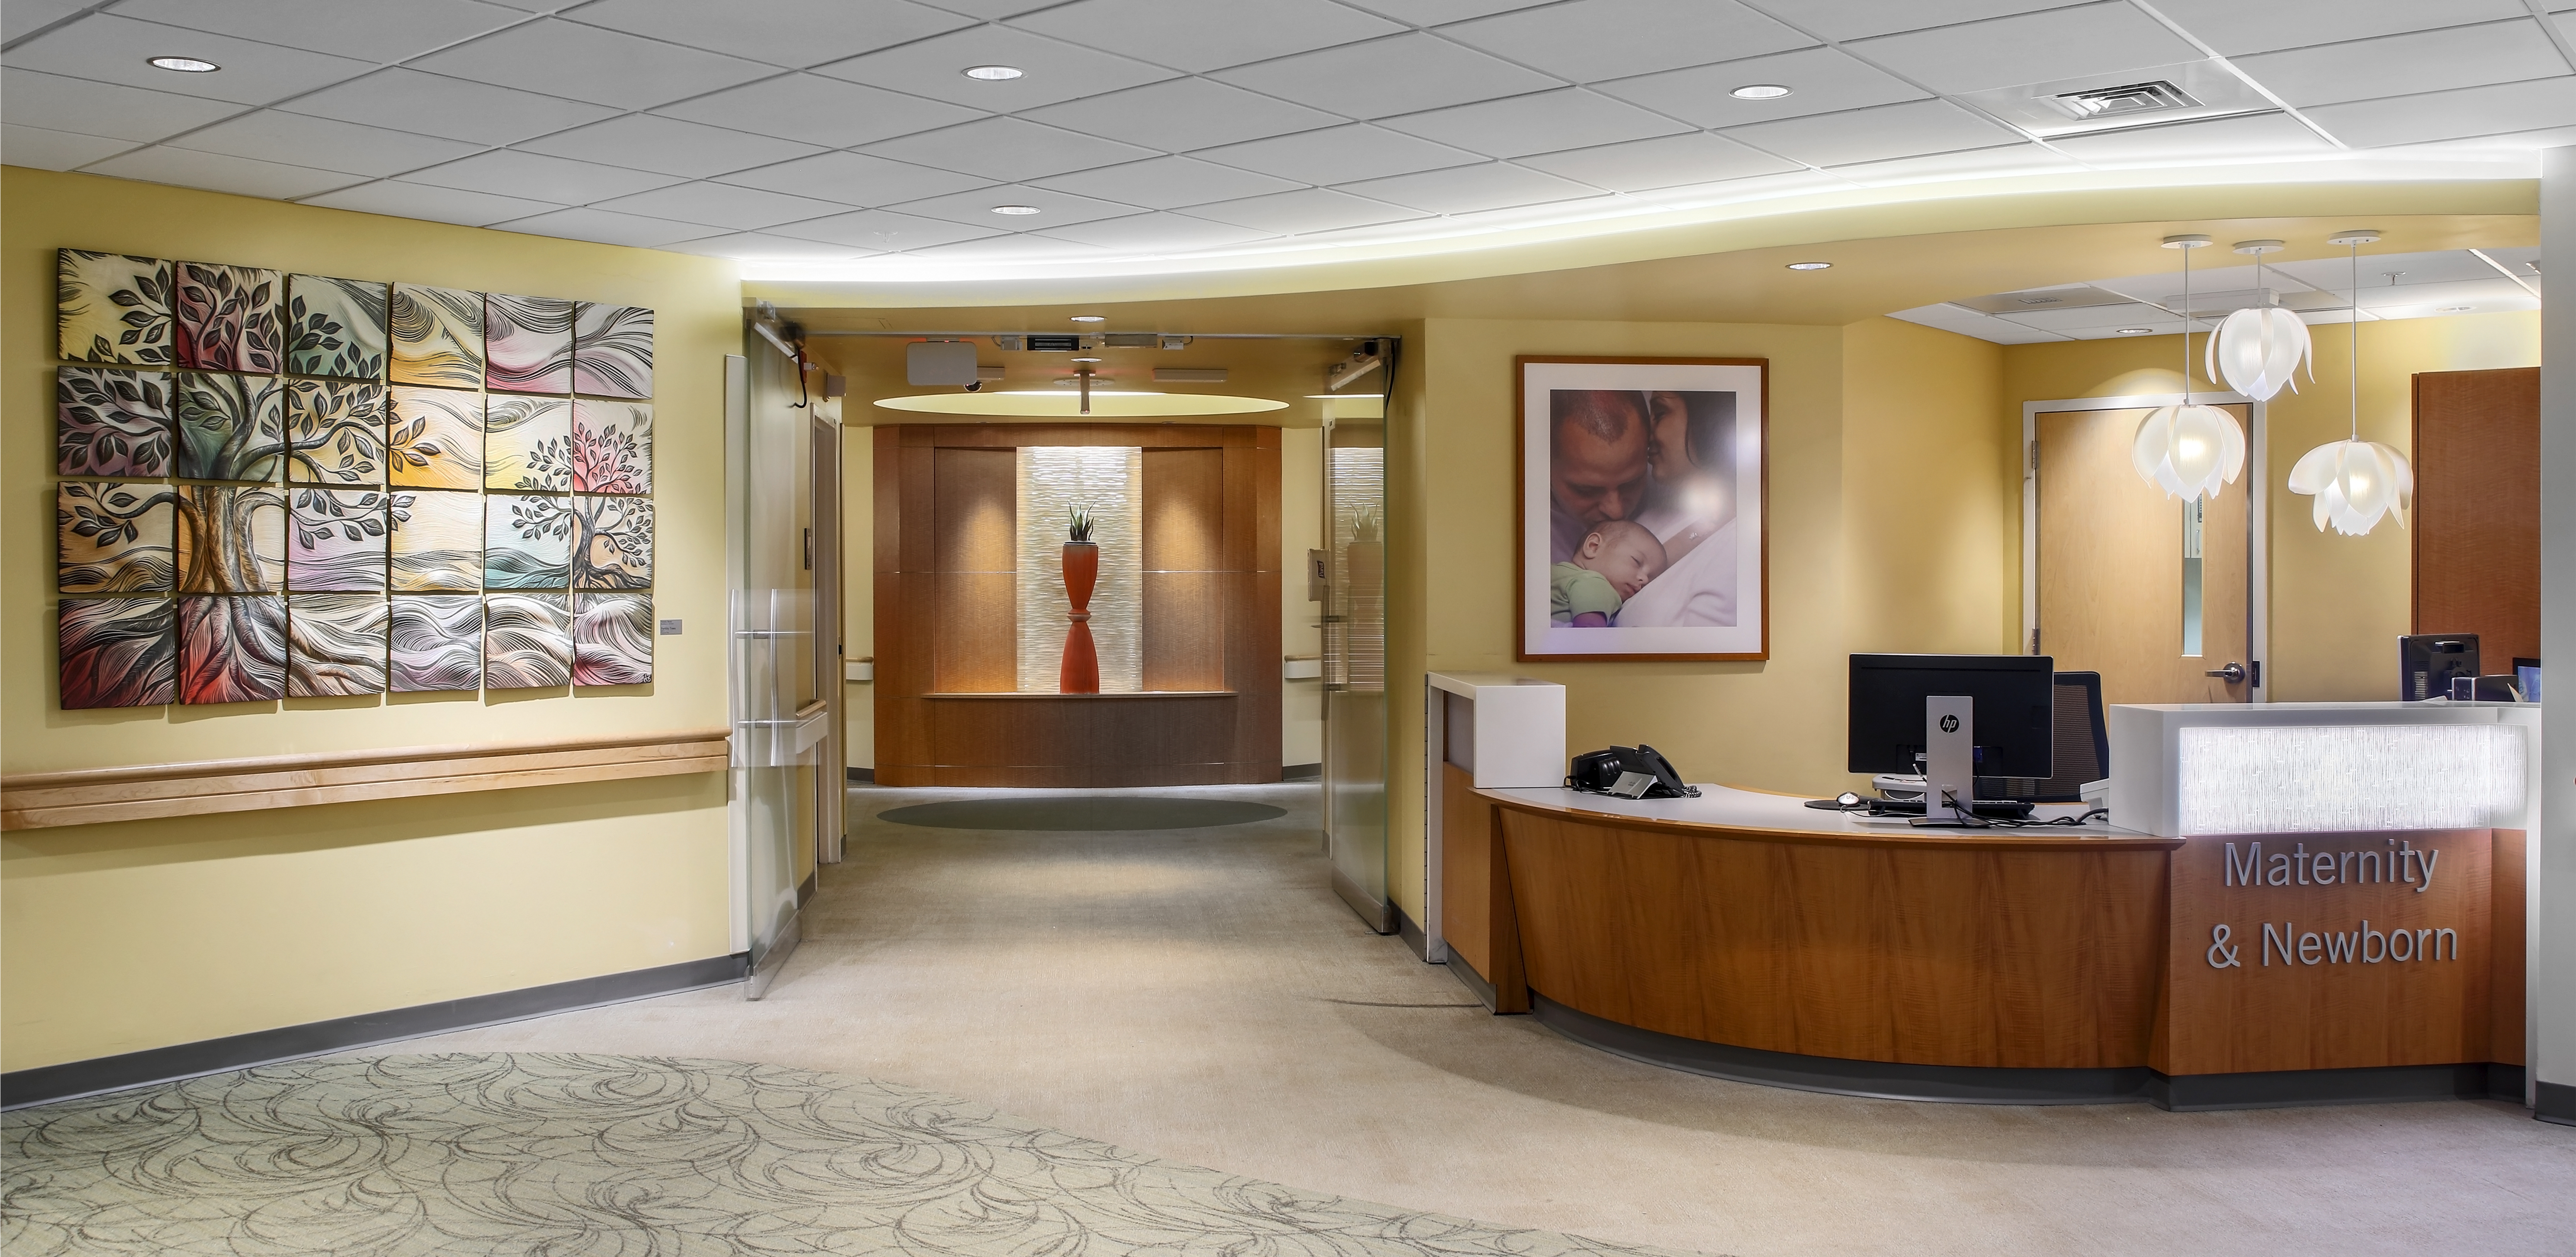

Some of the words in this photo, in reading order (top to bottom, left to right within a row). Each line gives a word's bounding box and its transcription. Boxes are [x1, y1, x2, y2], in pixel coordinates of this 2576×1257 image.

[1942, 714, 1957, 733] hp
[2225, 839, 2438, 892] Maternity
[2207, 924, 2240, 968] &
[2262, 920, 2457, 967] Newborn
